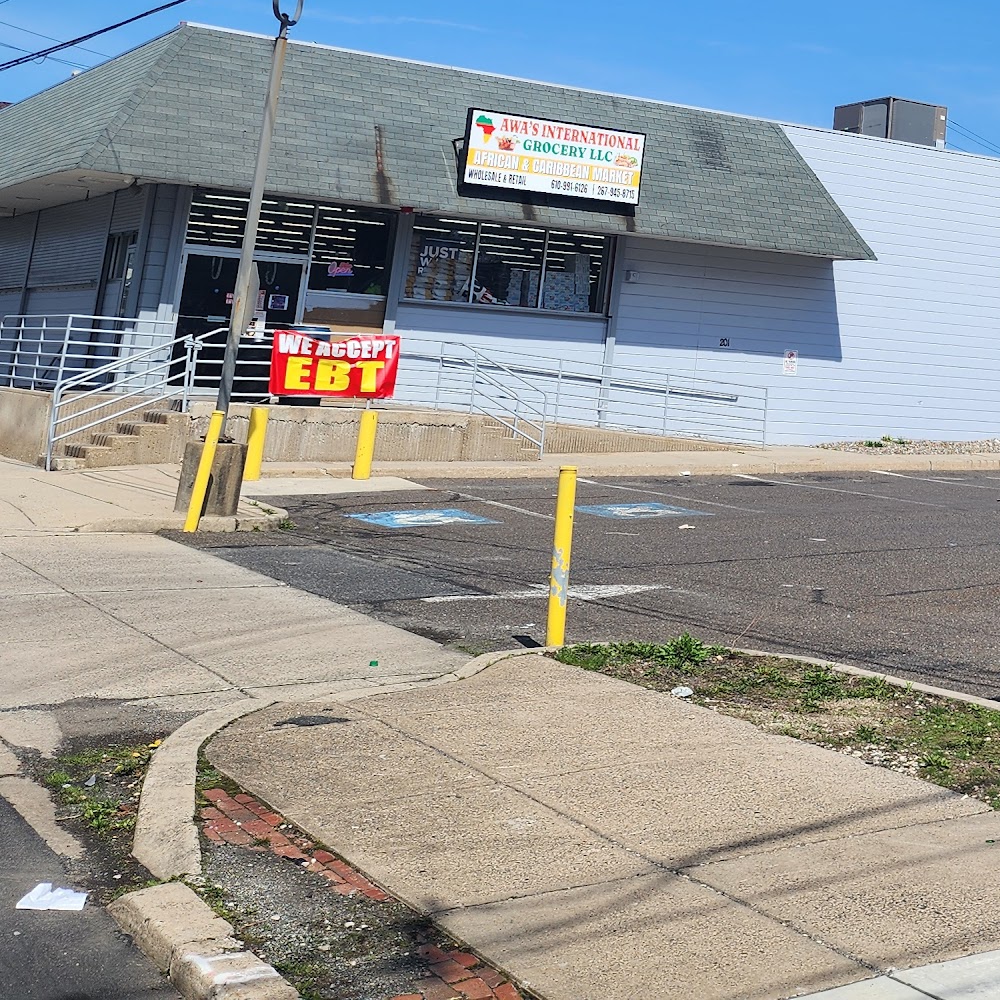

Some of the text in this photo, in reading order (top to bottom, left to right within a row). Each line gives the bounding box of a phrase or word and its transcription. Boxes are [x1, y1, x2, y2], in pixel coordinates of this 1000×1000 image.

[500, 118, 640, 151] AWA'S INTERNATIONAL
[523, 138, 613, 162] GROCERY LLC
[468, 168, 526, 186] WHOLESALE & RETAIL
[473, 151, 634, 185] AFRICAN & CARIBBEAN MARKET
[551, 179, 588, 194] 610-991-6126
[597, 186, 635, 199] 267-945-8715
[420, 246, 458, 259] JUST
[278, 333, 396, 359] WE ACCEPT
[719, 338, 730, 347] 201
[284, 356, 385, 393] EBT
